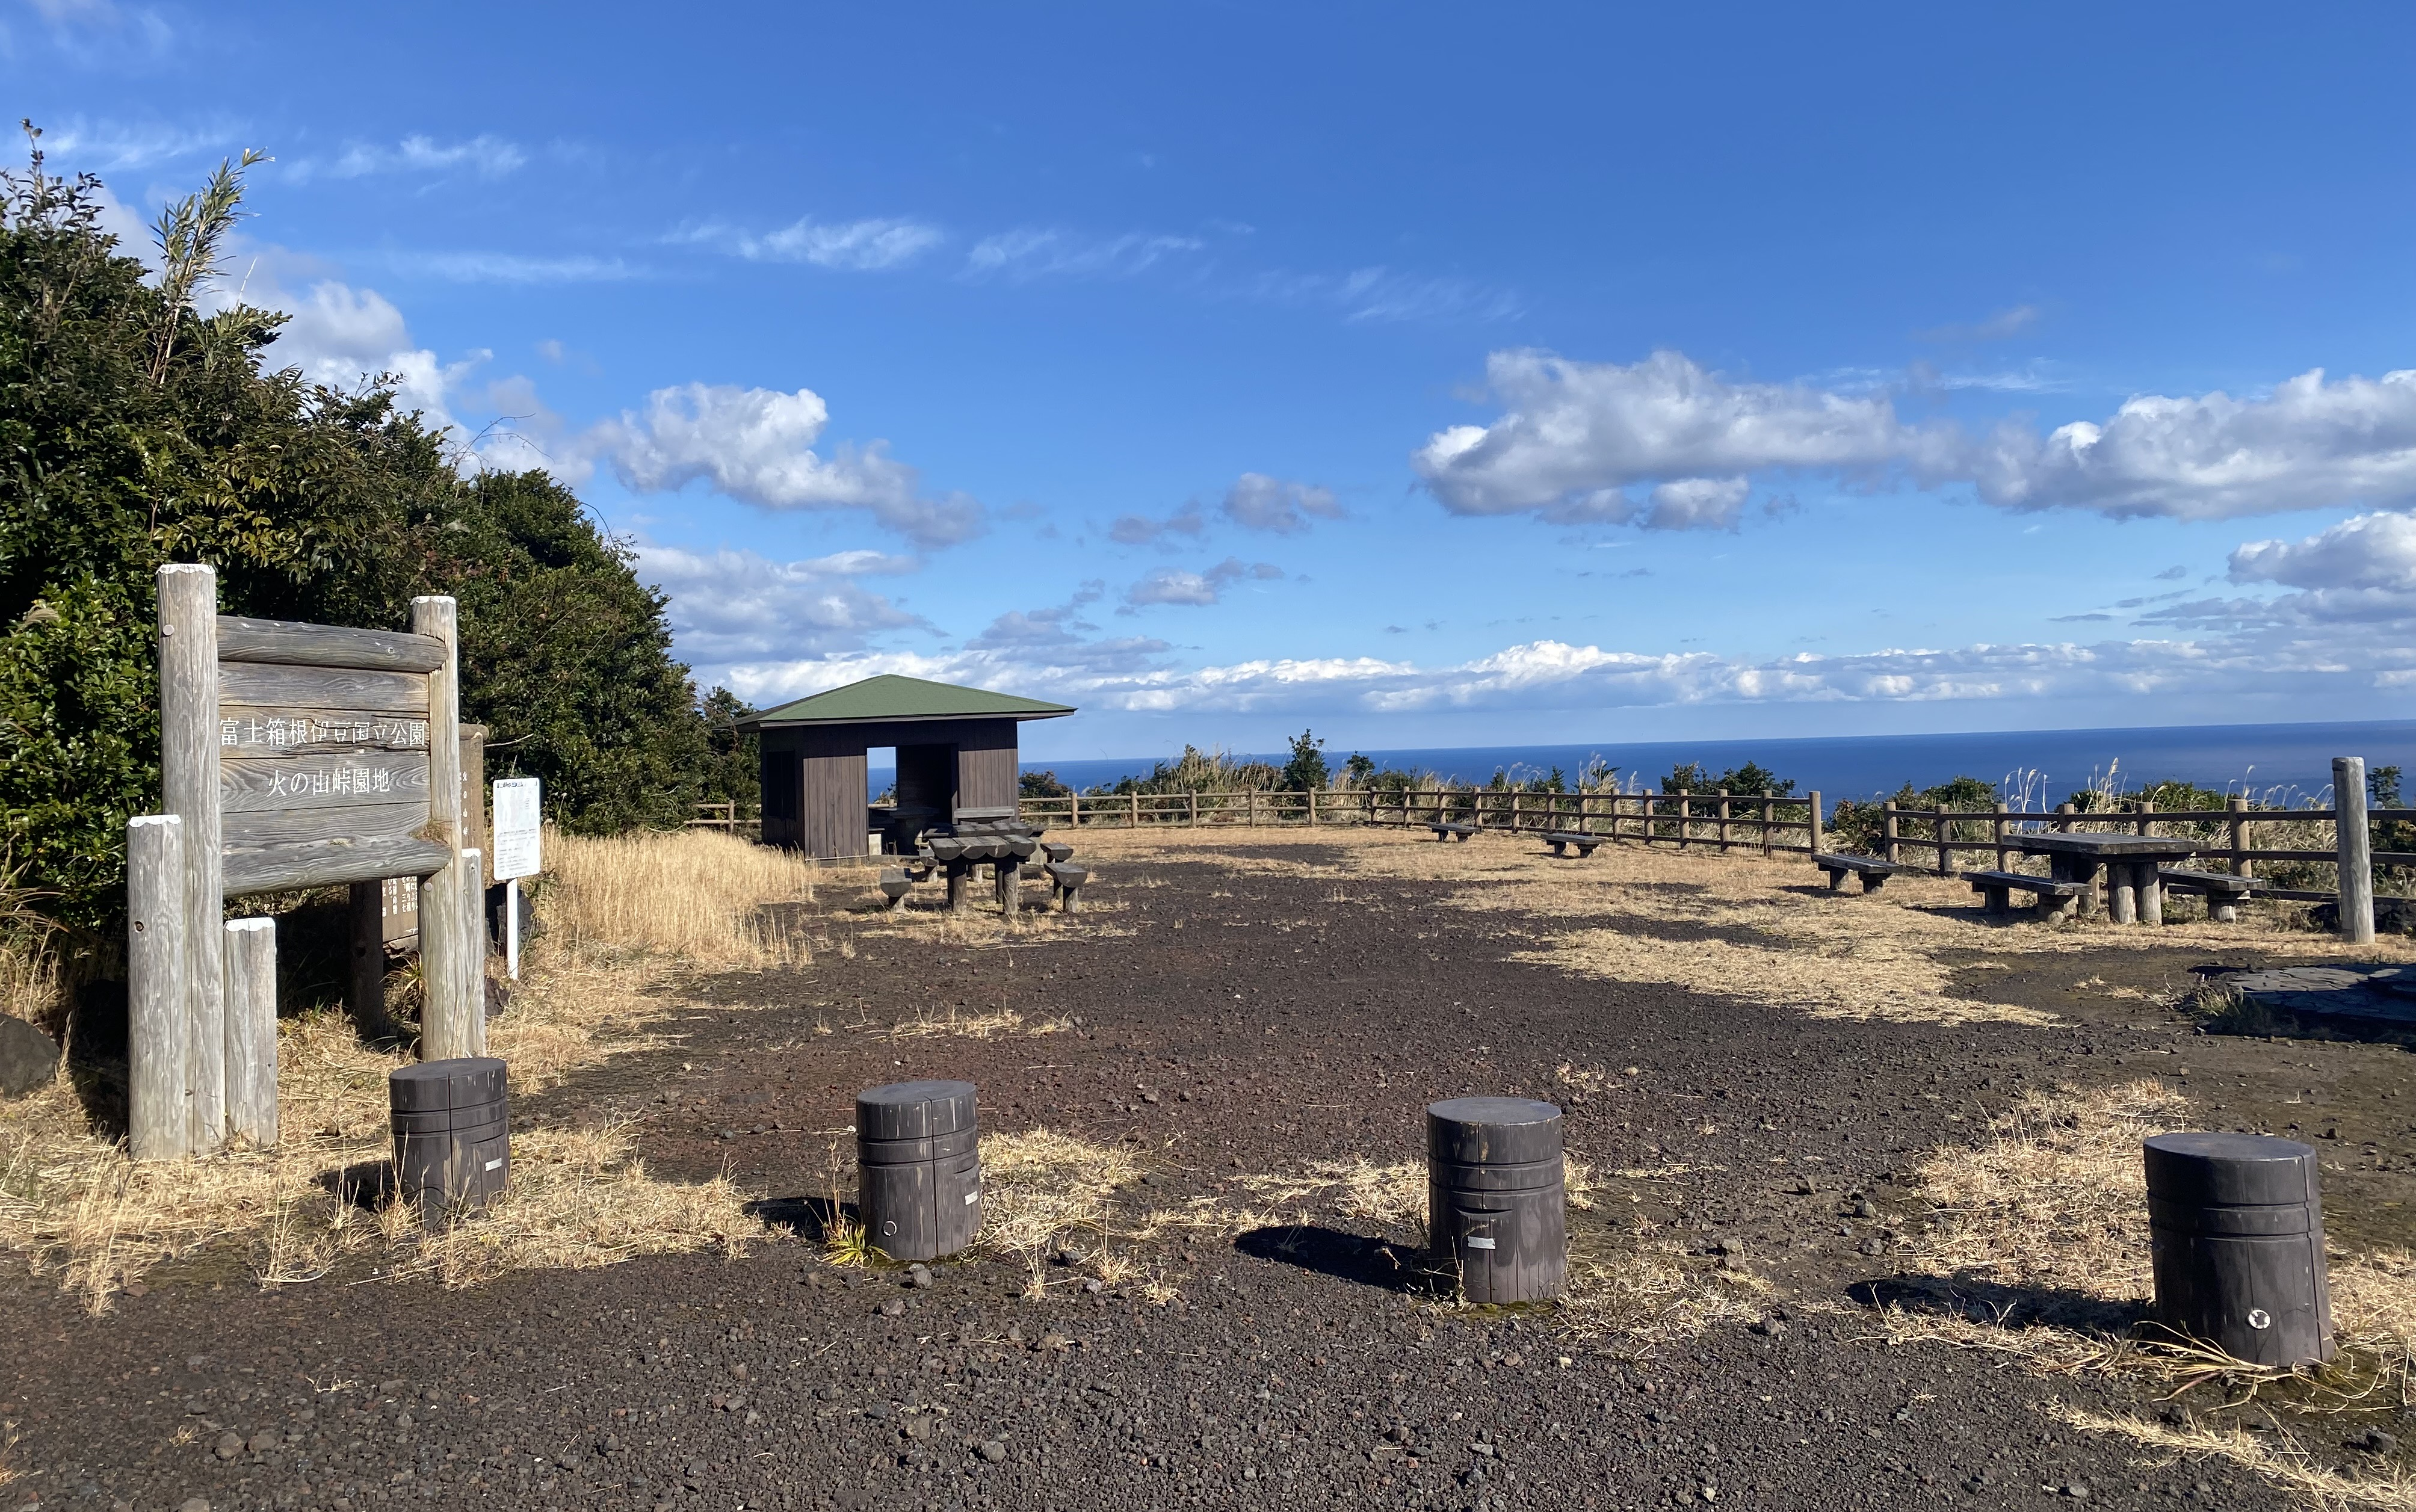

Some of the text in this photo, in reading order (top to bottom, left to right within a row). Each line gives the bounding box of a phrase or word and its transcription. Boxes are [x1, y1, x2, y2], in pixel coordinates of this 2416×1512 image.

[220, 717, 425, 746] 富士箱根伊豆国立公園
[267, 767, 391, 797] 火の山峠園地
